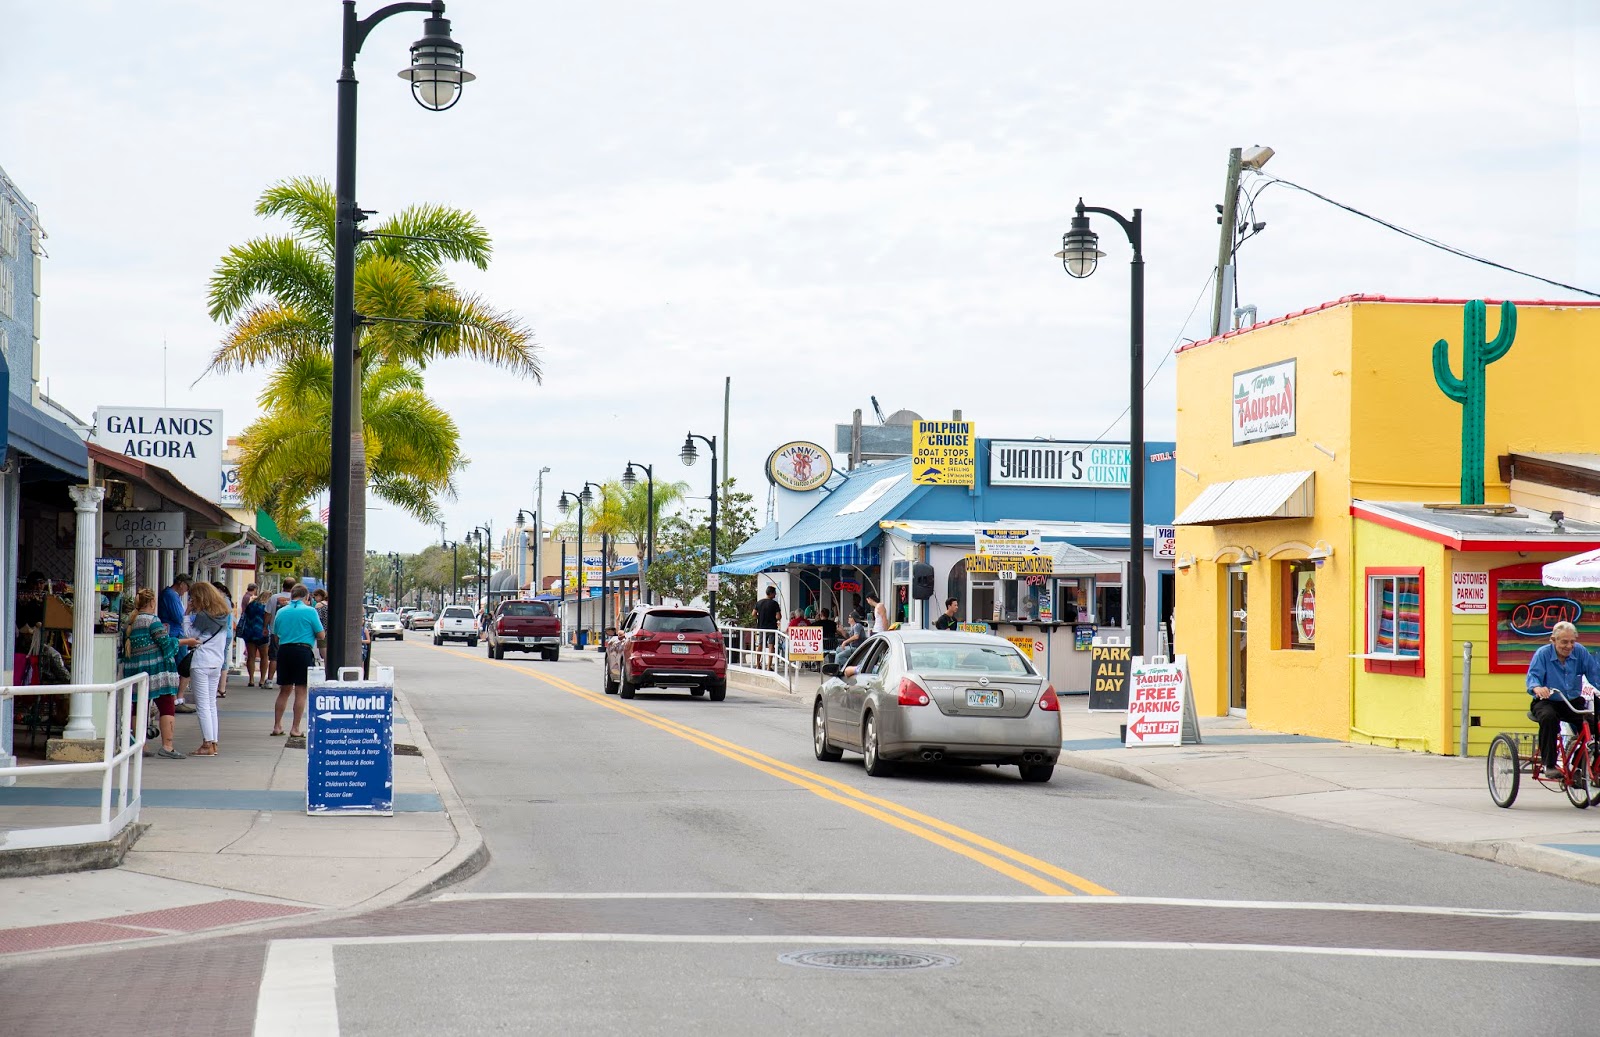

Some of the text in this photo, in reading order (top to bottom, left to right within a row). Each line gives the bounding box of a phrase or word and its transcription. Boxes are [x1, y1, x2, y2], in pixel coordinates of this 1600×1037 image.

[1235, 392, 1288, 428] TAQUERIA
[107, 415, 213, 436] GALANOS
[920, 422, 969, 434] DOLPHIN
[928, 434, 968, 446] CRUISE
[124, 439, 196, 458] AGORA
[780, 446, 821, 460] YIANNI'S
[918, 448, 969, 457] BOAT STOPS
[913, 456, 974, 466] ON THE BEACH
[1091, 448, 1131, 466] GREEK
[1087, 465, 1129, 483] CUISIN
[115, 513, 167, 534] Captain
[125, 533, 162, 548] Pete's
[966, 555, 987, 571] DOLPHIN
[1017, 556, 1034, 572] ISLAND
[1035, 556, 1053, 573] CRUISE
[1002, 571, 1013, 580] 510
[1026, 574, 1048, 586] OPEN
[1453, 573, 1487, 584] CUSTOMER
[833, 581, 863, 593] OPEN
[1457, 588, 1484, 599] PARKING
[1512, 604, 1576, 629] OPEN
[790, 629, 822, 640] PARKING
[958, 624, 987, 634] TCKETS
[1092, 647, 1131, 661] PARK
[1097, 663, 1125, 676] ALL
[1095, 678, 1125, 692] DAY
[1136, 673, 1180, 685] TAQUERIA
[1136, 687, 1177, 701] FREE
[315, 695, 385, 710] Gift World
[1130, 701, 1181, 713] PARKING
[1136, 722, 1179, 733] NEXT LEFT
